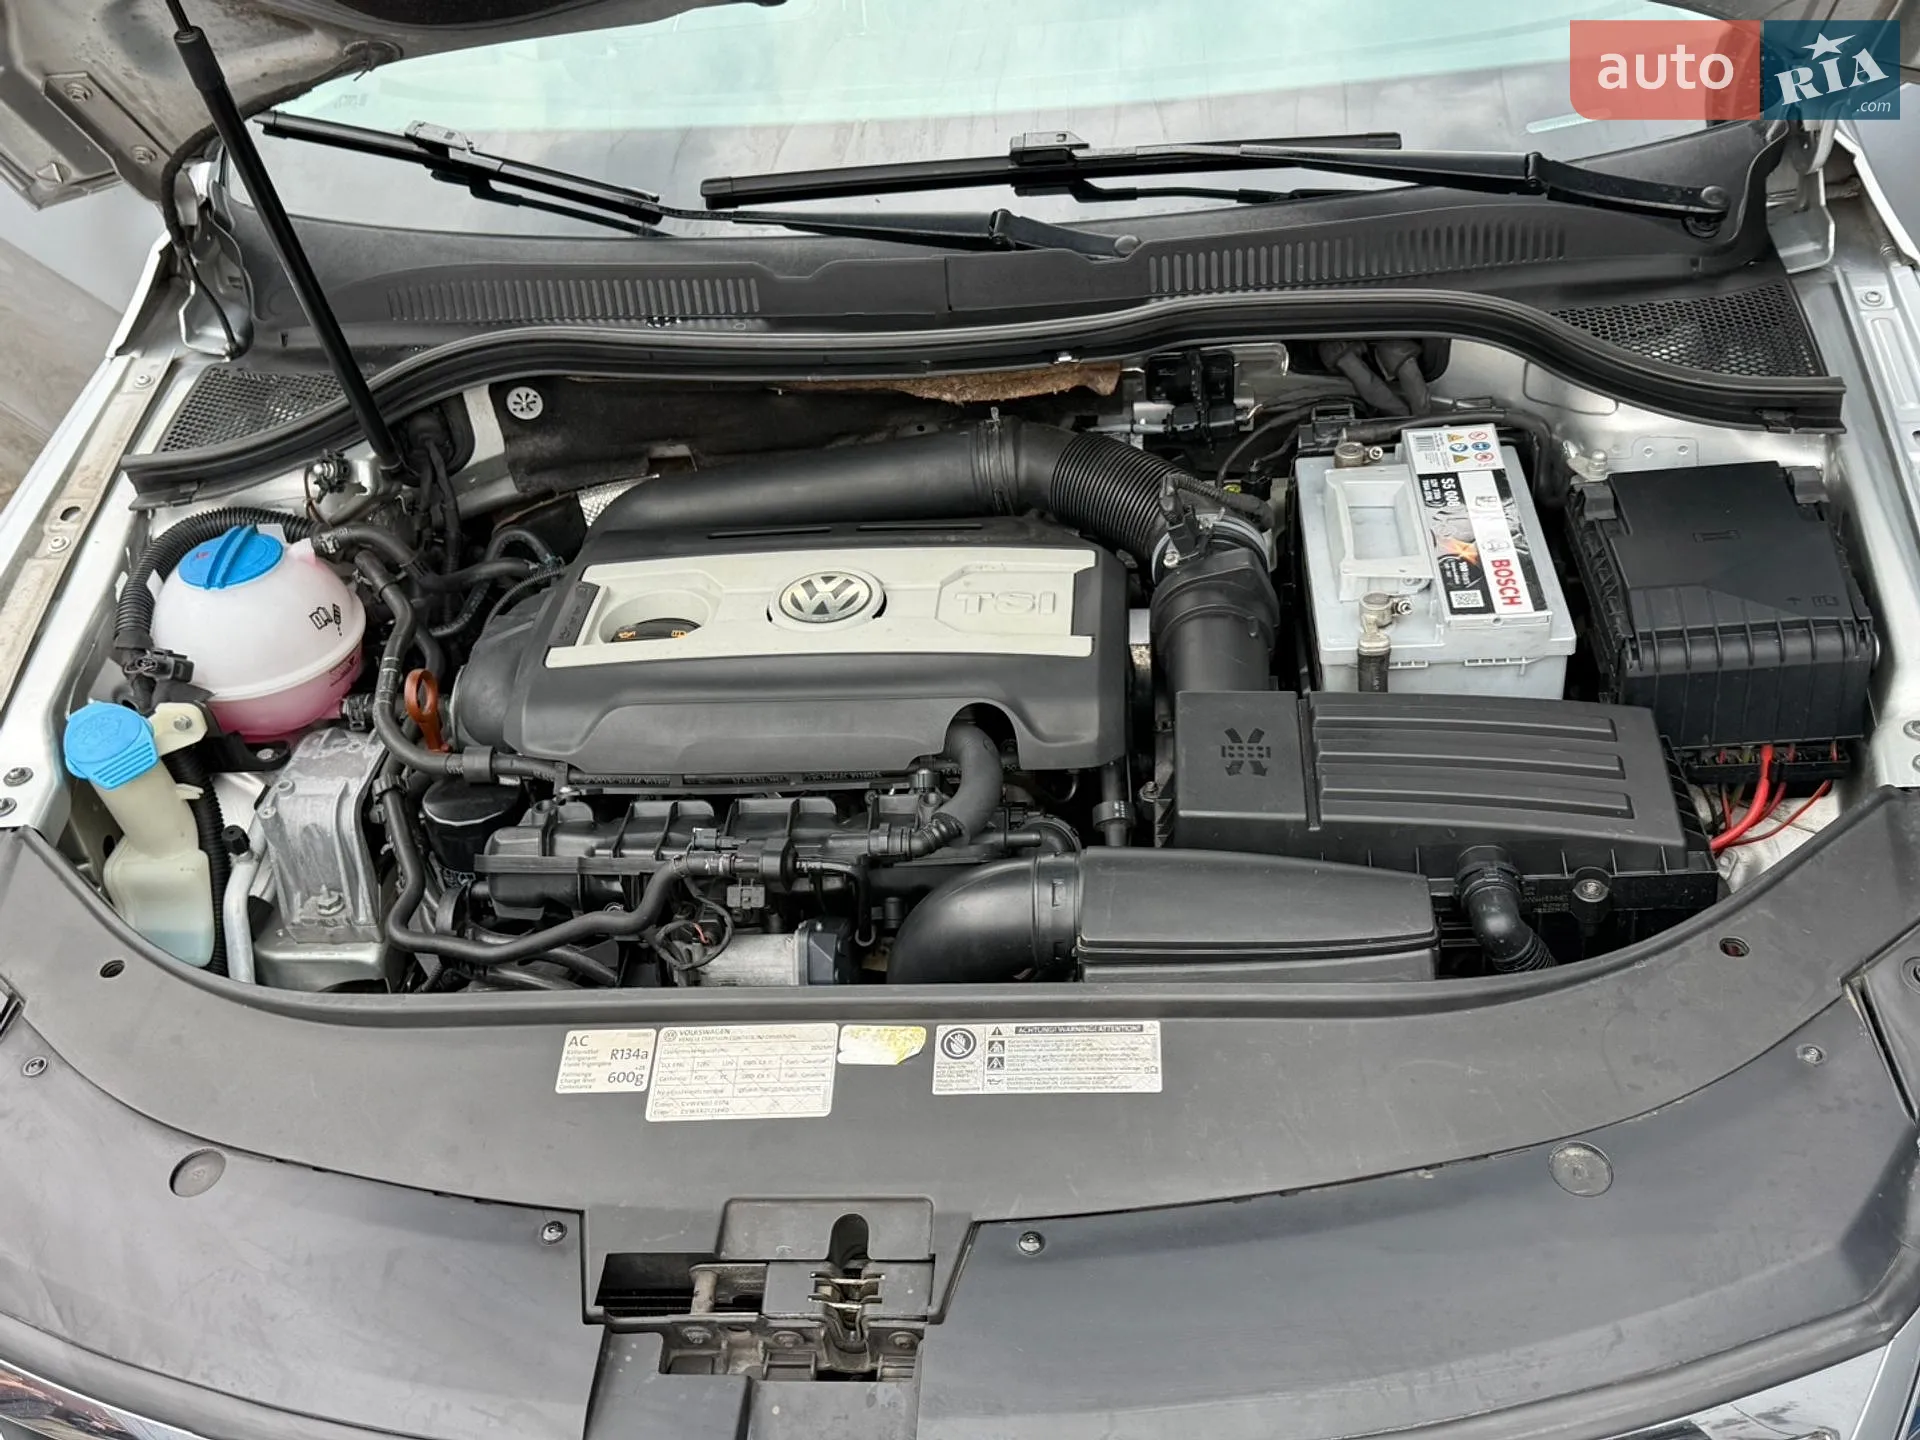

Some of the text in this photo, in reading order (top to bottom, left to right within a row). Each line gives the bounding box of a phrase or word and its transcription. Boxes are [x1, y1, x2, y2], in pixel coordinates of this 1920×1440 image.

[1441, 478, 1456, 489] S5
[1490, 558, 1523, 608] BOSCH
[955, 591, 1057, 615] TSI
[568, 1035, 589, 1047] AC
[610, 1048, 648, 1060] R134a
[607, 1071, 644, 1086] 600g
